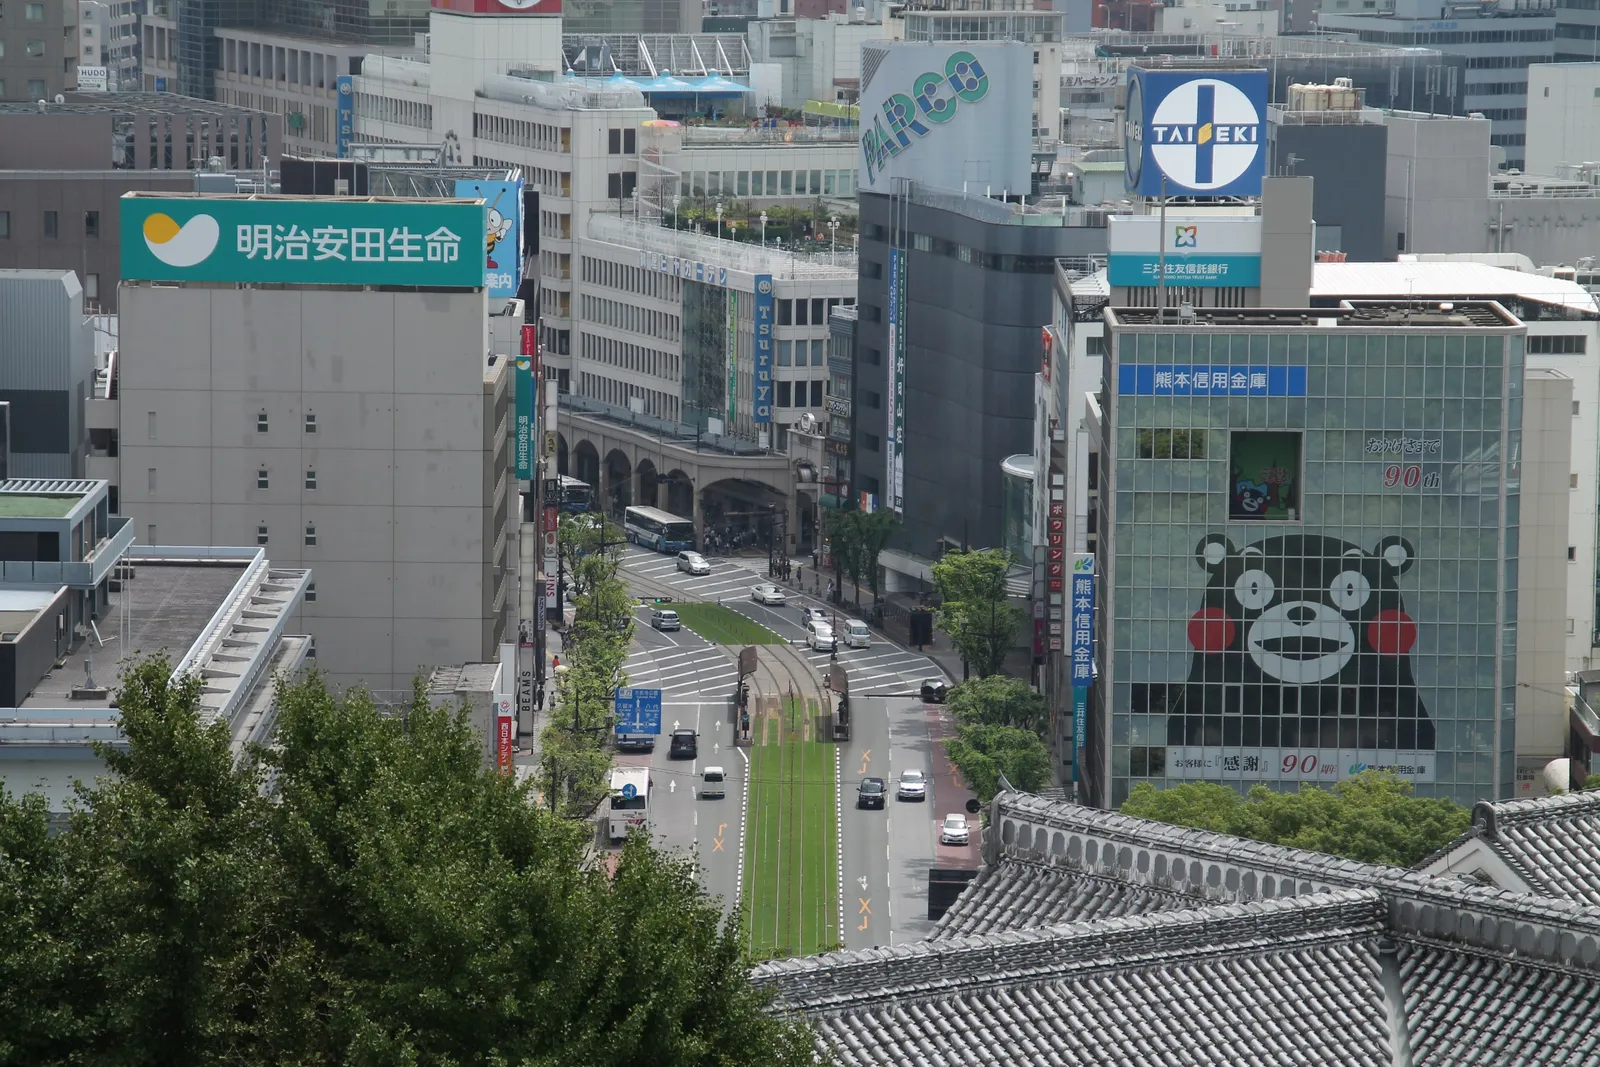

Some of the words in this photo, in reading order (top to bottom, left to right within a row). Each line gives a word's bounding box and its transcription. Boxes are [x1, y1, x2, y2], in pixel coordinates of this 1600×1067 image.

[81, 69, 106, 77] HUDO
[861, 51, 990, 186] PARCO
[1153, 122, 1257, 146] TAISEKI
[236, 223, 462, 264] 明治安田生命
[1142, 263, 1229, 274] 三井住友信託銀行
[757, 306, 770, 417] Tsuruya
[1155, 371, 1267, 389] 熊本信用金庫
[896, 356, 904, 444] 好日山荘
[518, 415, 529, 470] 明治安田生命
[1366, 437, 1441, 454] おかげさまで
[546, 572, 555, 598] JINS
[1074, 578, 1091, 680] 熊本信用金庫
[522, 670, 532, 712] BEAMS
